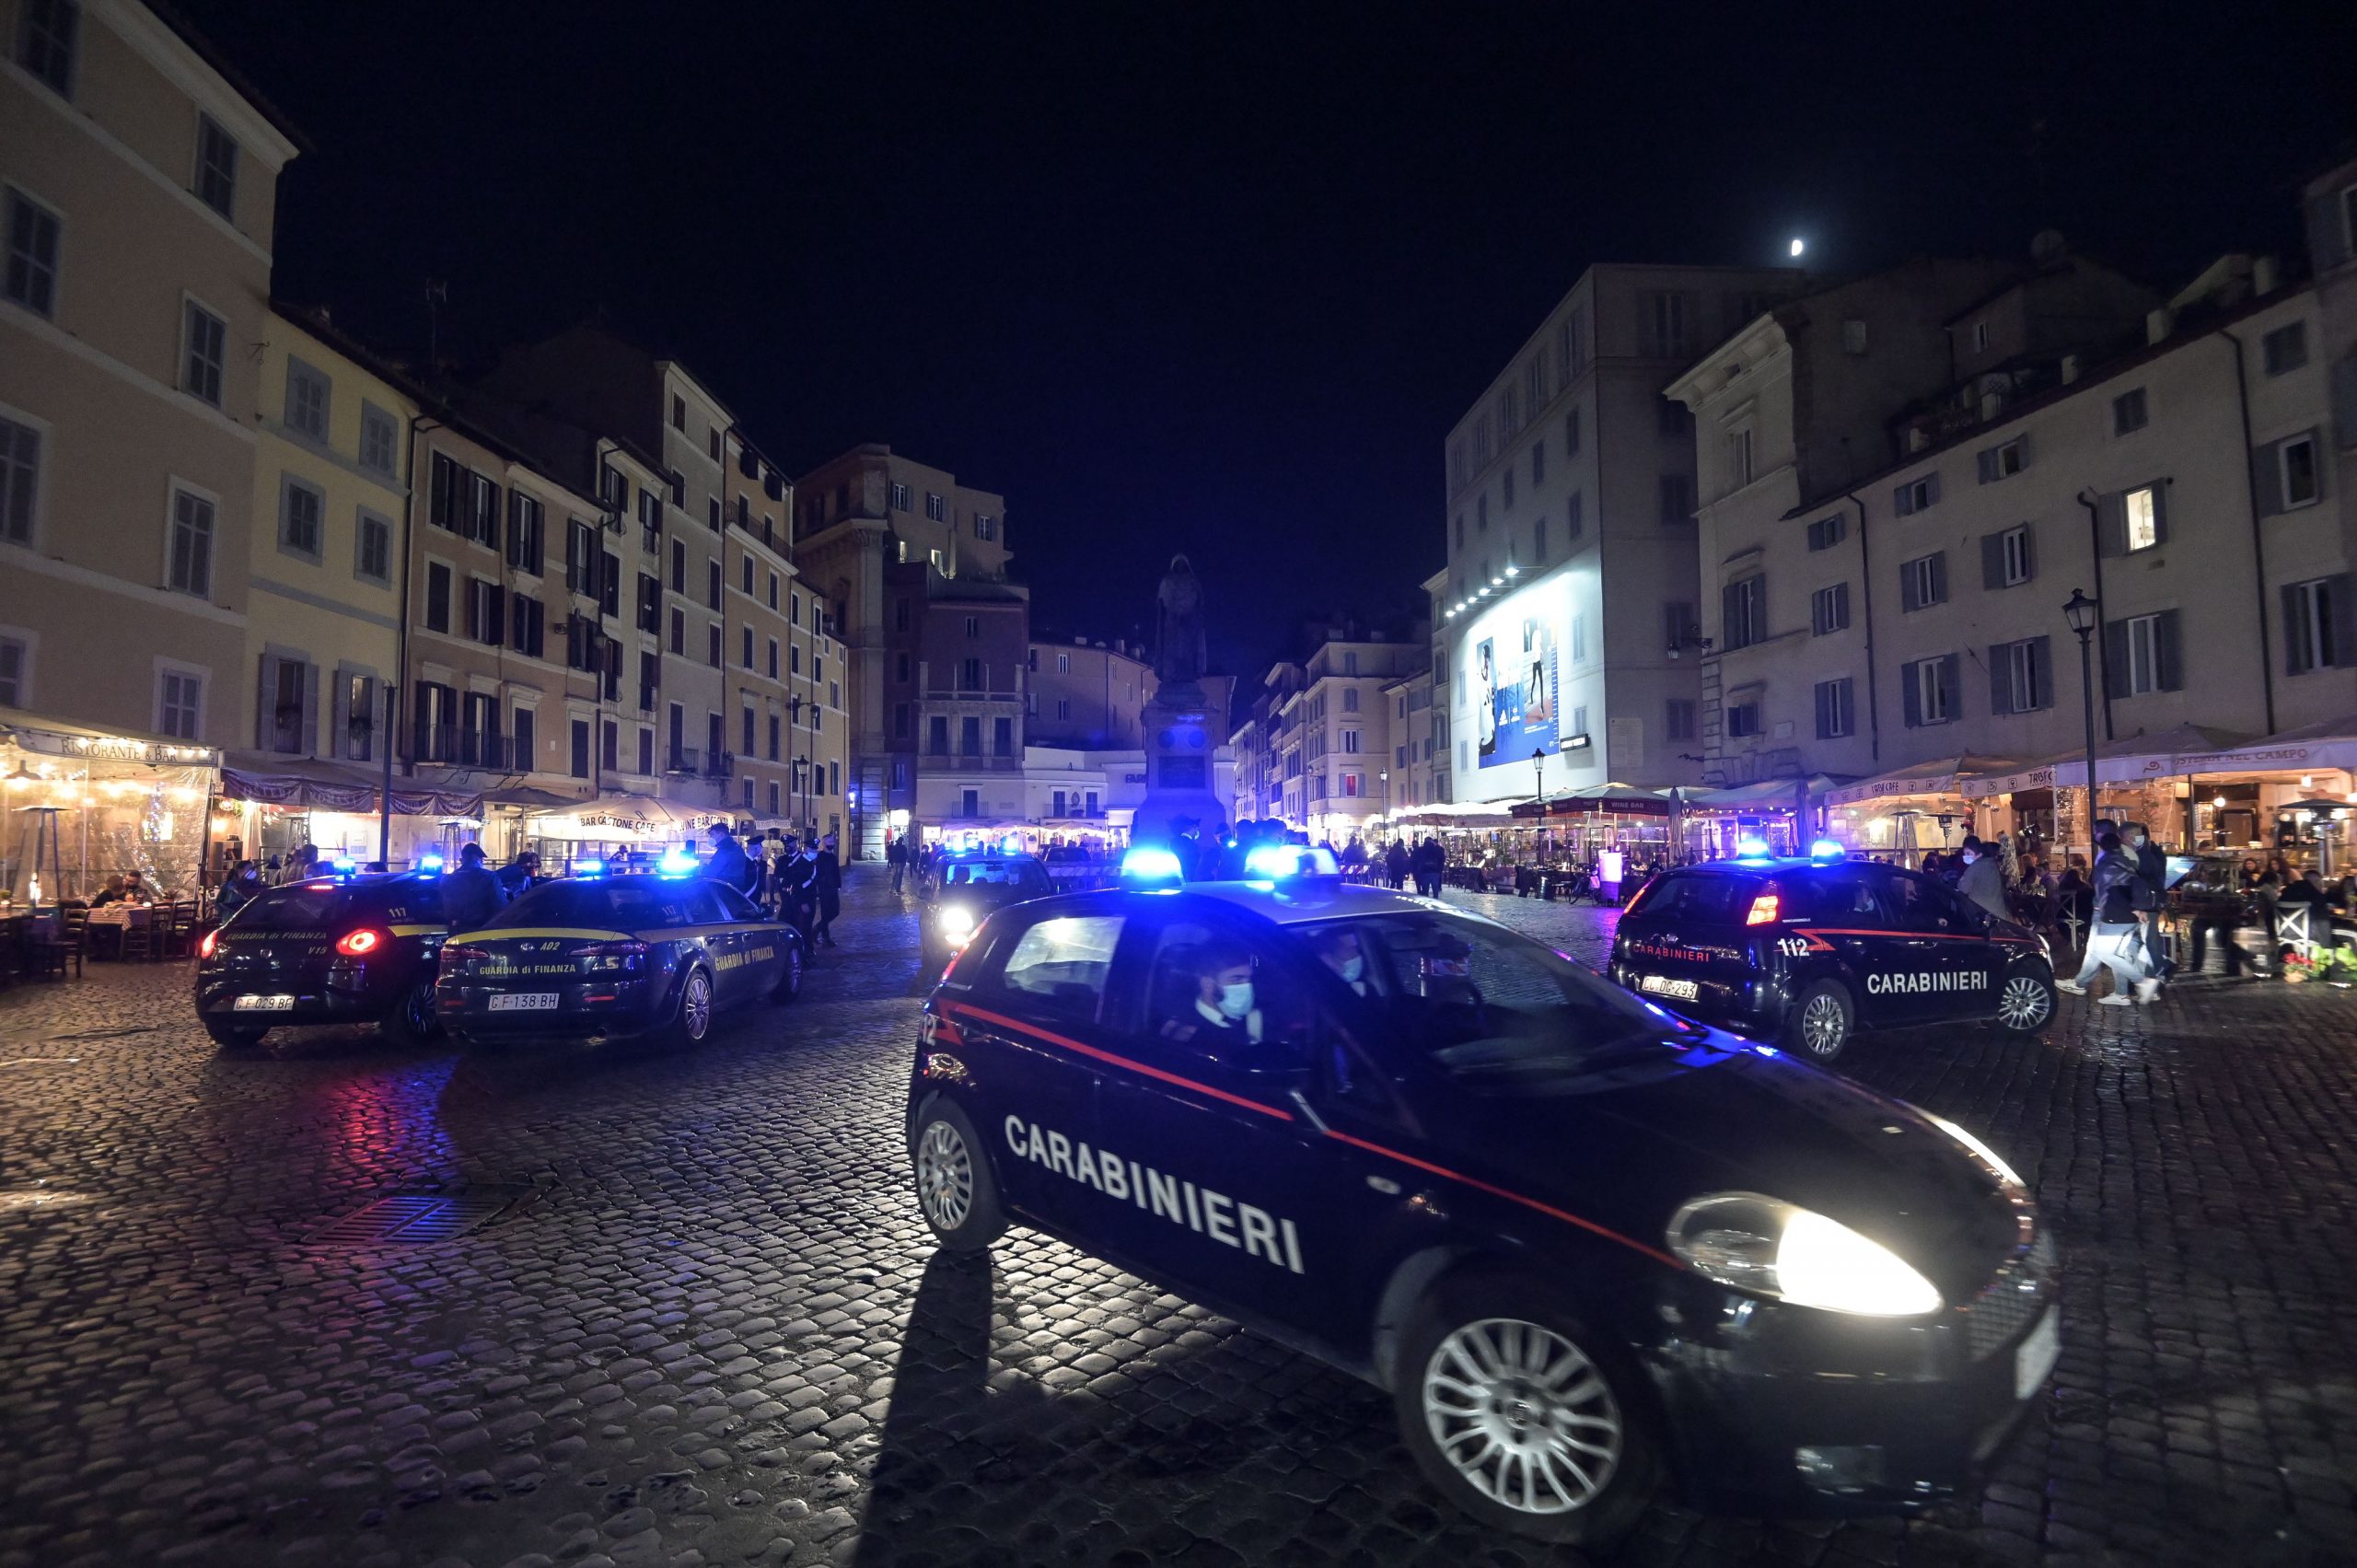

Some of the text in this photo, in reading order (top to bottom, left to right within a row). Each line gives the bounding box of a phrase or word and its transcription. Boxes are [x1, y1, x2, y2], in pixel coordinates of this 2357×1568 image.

[145, 750, 152, 761] &
[2255, 749, 2307, 761] CAMPO
[580, 817, 596, 827] BAR
[697, 816, 710, 828] BAR
[389, 907, 407, 918] 117
[282, 932, 327, 940] FINANZA
[1632, 943, 1710, 963] CARABINIERI
[1777, 937, 1810, 957] 112
[714, 946, 774, 971] GUARDIA di FINANZA
[479, 964, 576, 975] GUARDIA di FINANZA
[1867, 970, 1988, 994] CARABINIERI
[1004, 1114, 1305, 1274] CARABINIERI
